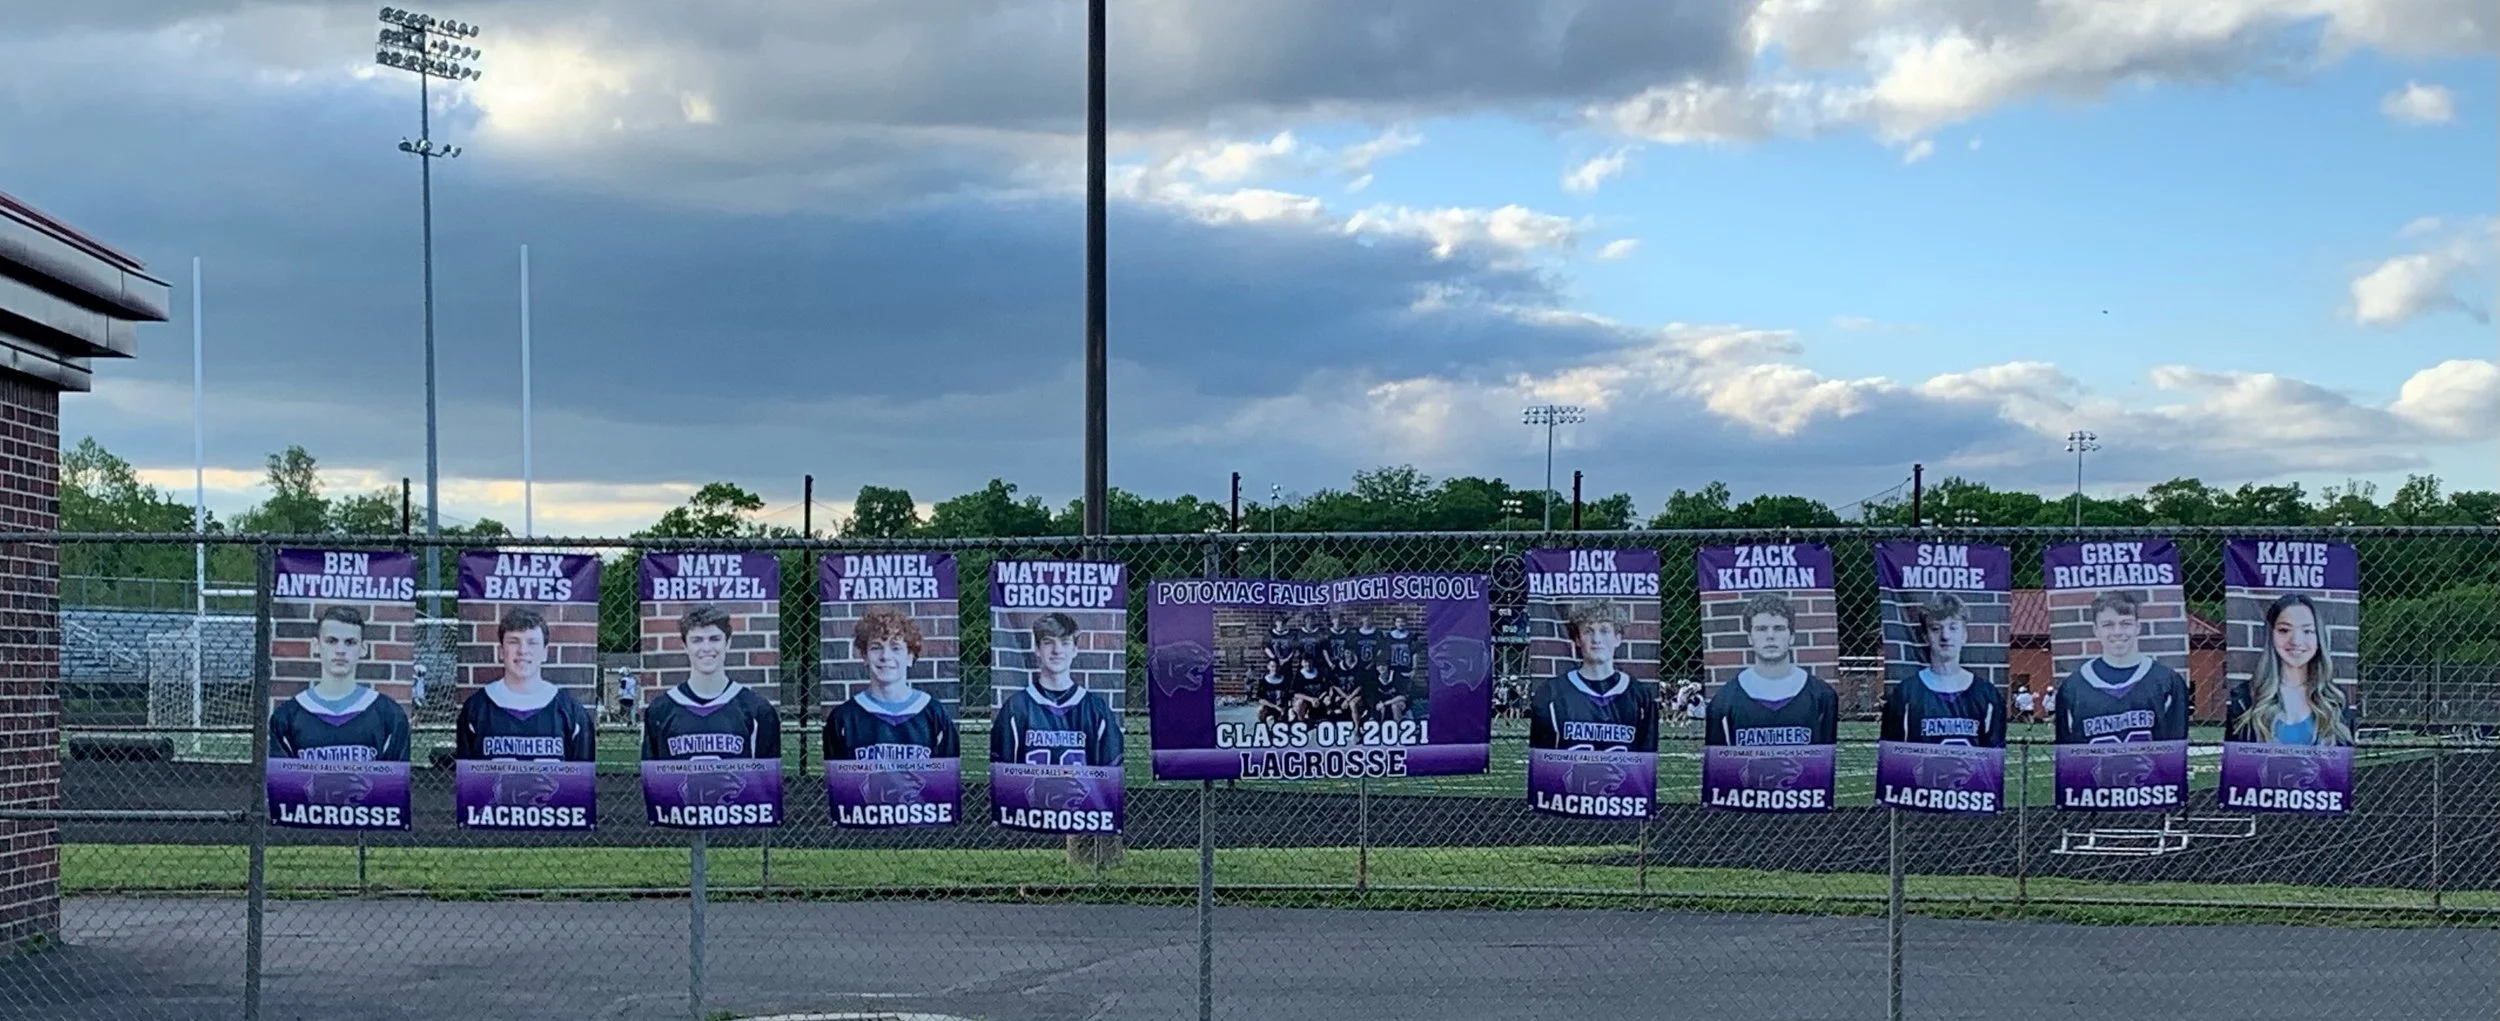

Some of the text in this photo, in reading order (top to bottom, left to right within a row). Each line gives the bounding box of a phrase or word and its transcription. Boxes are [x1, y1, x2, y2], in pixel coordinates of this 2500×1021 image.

[324, 551, 369, 575] BEN
[494, 553, 564, 578] ALEX
[677, 554, 742, 577] NATE
[1569, 550, 1617, 572] JACK
[1734, 545, 1798, 567] ZACK
[1917, 544, 1969, 567] SAM
[2081, 542, 2143, 565] GREY
[2257, 541, 2328, 566] KATIE
[843, 554, 934, 578] DANIEL
[997, 561, 1120, 586] MATTHEW
[1717, 566, 1816, 590] KLOMAN
[1902, 566, 1985, 589] MOORE
[2053, 563, 2174, 588] RICHARDS
[2260, 564, 2324, 588] TANG
[275, 573, 415, 600] ANTONELLIS
[484, 576, 572, 600] BATES
[653, 577, 766, 600] BRETZEL
[838, 577, 939, 600] FARMER
[1158, 575, 1479, 606] POTOMAC FALLS HIGH SCHOOL
[1528, 572, 1659, 595] HARGREAVES
[1004, 584, 1113, 608] GROSCUP
[1216, 720, 1429, 749] CLASS OF 2021
[2083, 710, 2155, 737] PANTHERS
[483, 736, 564, 756] PANTHERS
[1735, 726, 1812, 746] PANTHERS
[1240, 749, 1407, 779] LACROSSE
[1537, 791, 1648, 817] LACROSSE
[1711, 787, 1826, 810] LACROSSE
[1885, 784, 1996, 812] LACROSSE
[2065, 785, 2178, 808] LACROSSE
[2228, 786, 2343, 811] LACROSSE
[279, 803, 401, 826] LACROSSE
[467, 805, 587, 826] LACROSSE
[655, 803, 773, 826] LACROSSE
[838, 802, 953, 825] LACROSSE
[1000, 806, 1114, 831] LACROSSE
